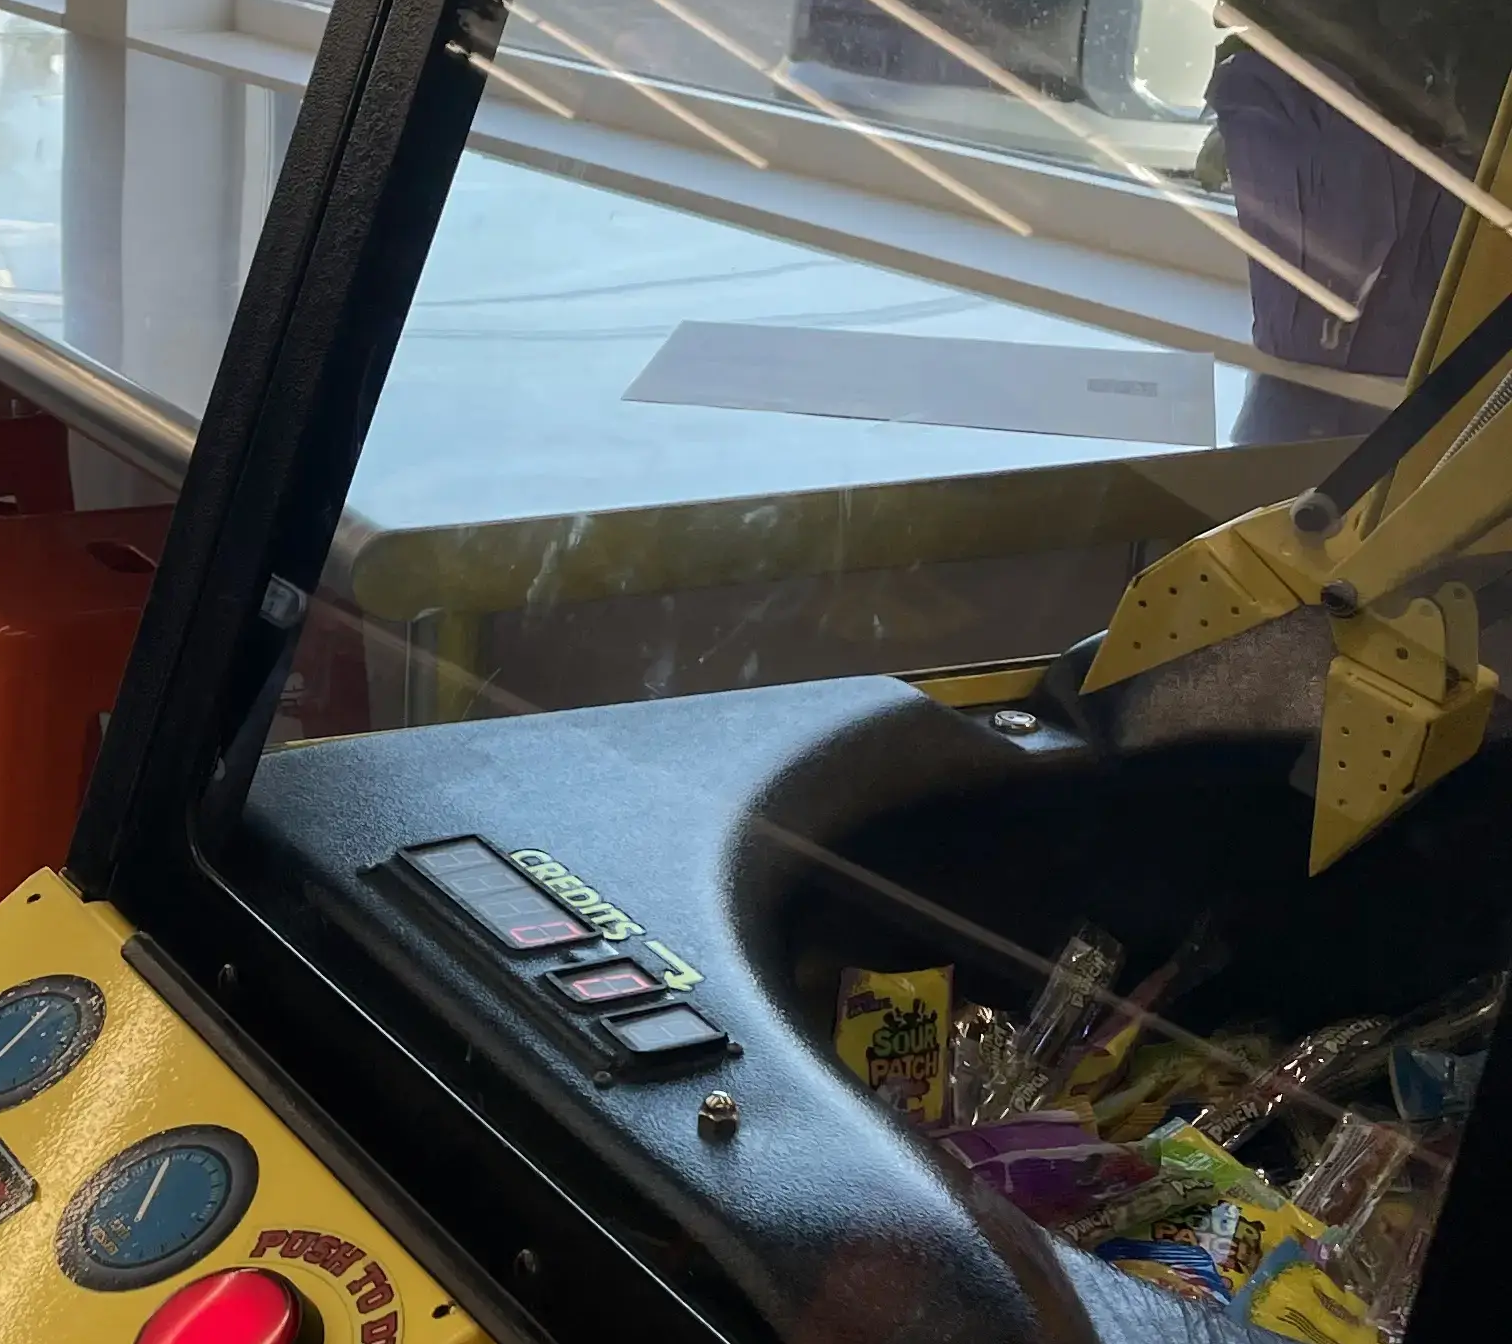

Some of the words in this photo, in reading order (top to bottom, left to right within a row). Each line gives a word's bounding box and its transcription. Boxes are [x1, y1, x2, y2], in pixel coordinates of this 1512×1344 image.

[509, 848, 646, 941] CREDITS
[875, 1025, 936, 1053] SOUR
[869, 1051, 939, 1087] PATCH
[1207, 1101, 1259, 1142] PUNCH
[1064, 1211, 1111, 1241] PUNCH
[251, 1230, 365, 1277] PUSH
[347, 1263, 397, 1312] TO
